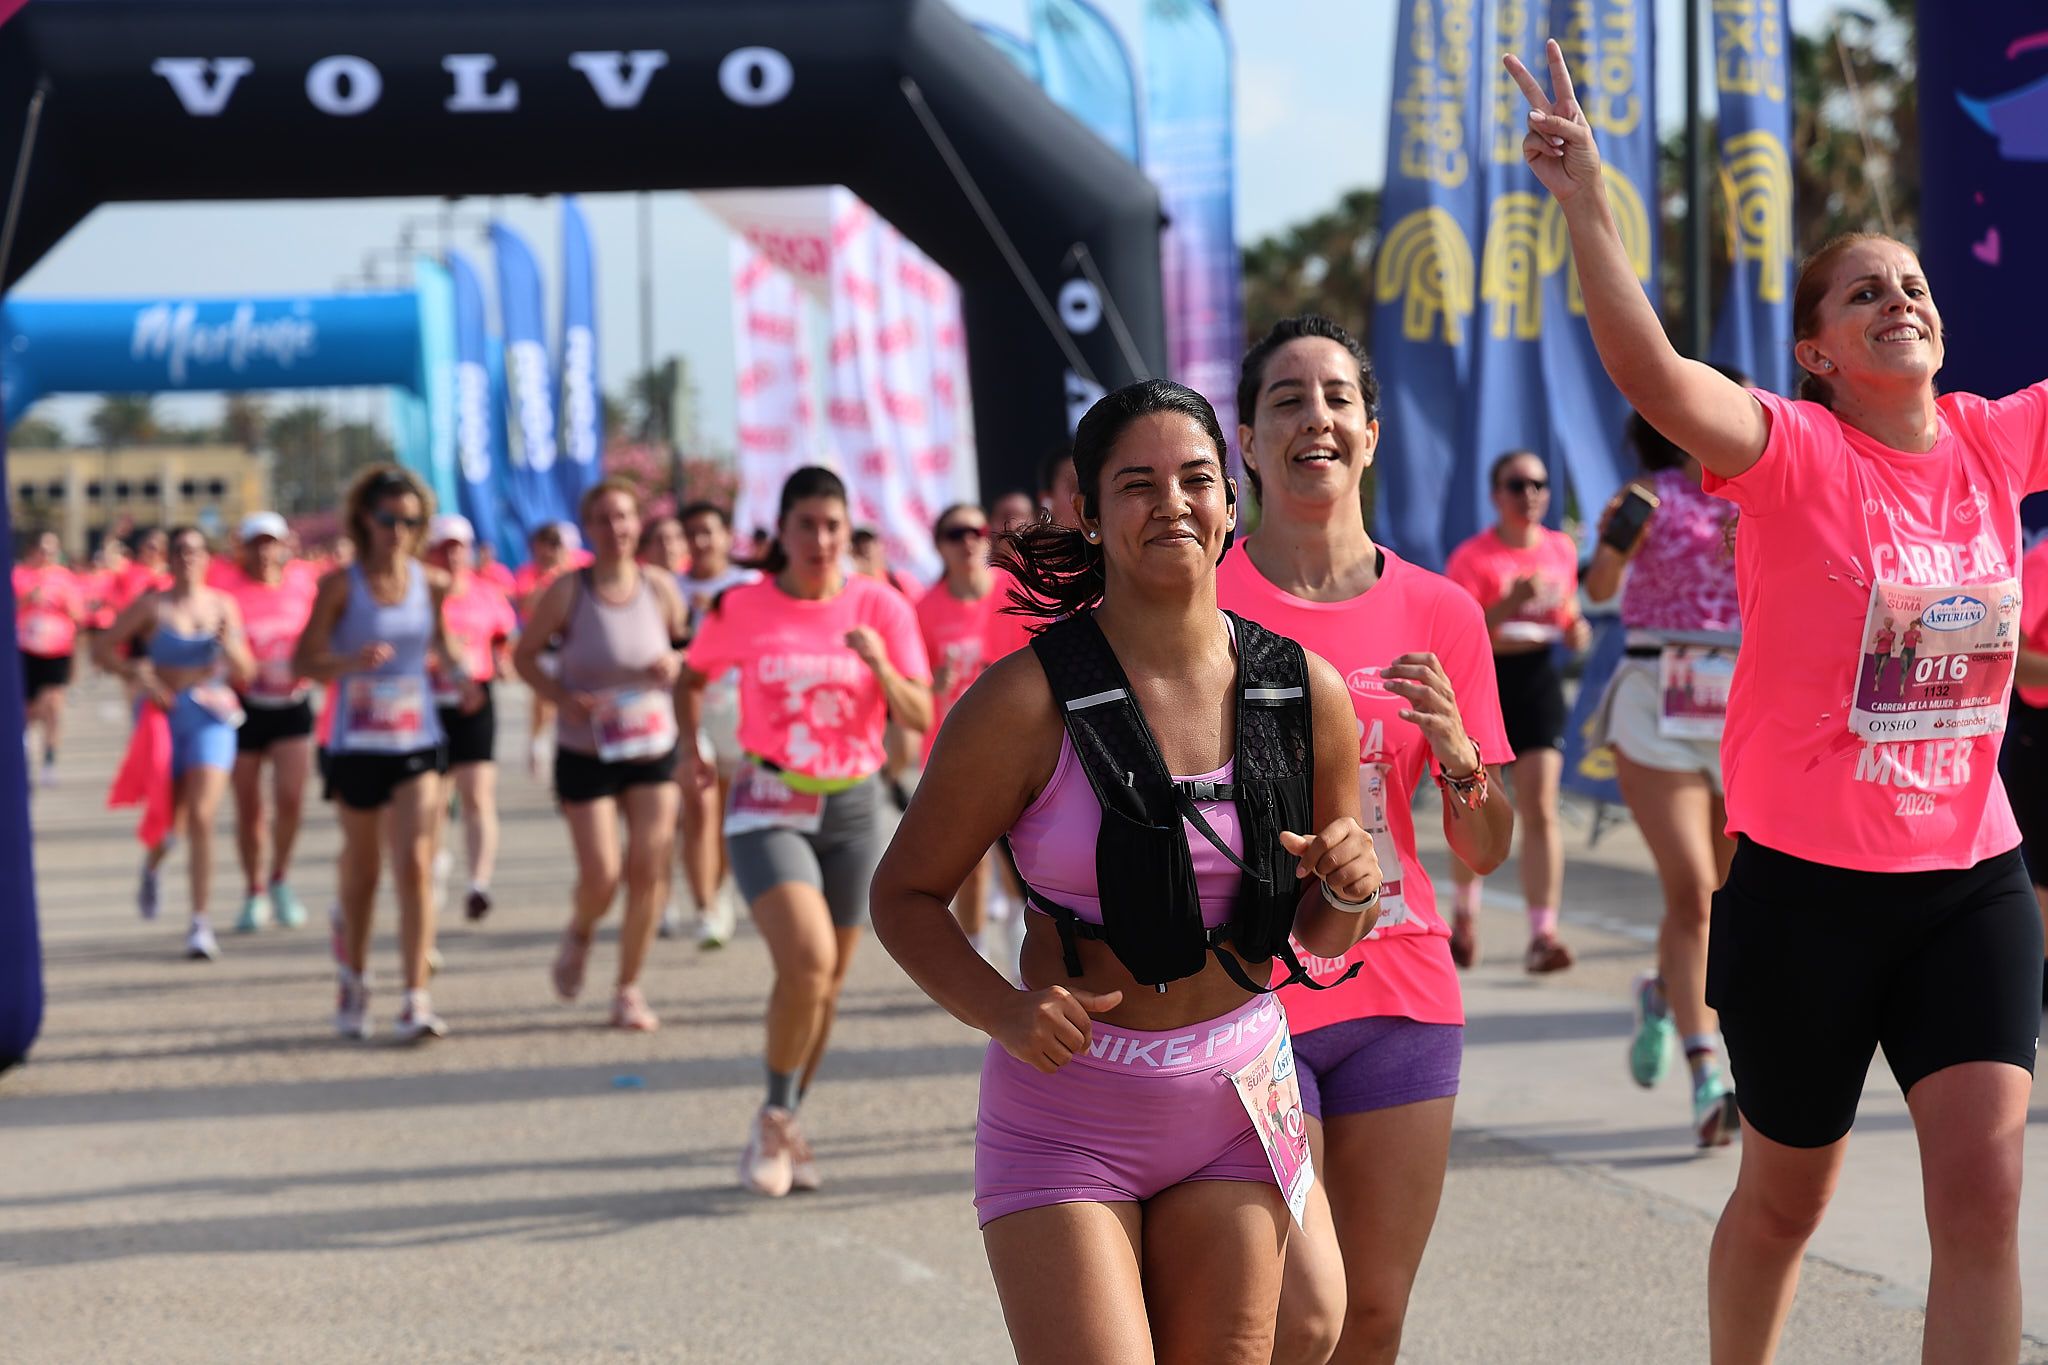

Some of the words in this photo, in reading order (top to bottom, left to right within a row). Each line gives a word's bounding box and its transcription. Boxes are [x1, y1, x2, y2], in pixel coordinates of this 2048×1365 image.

[153, 46, 794, 116] VOLVO
[1872, 534, 2006, 586] CARRERA
[1887, 599, 1922, 613] SUMA
[1926, 610, 1982, 623] ASTURIANA
[1914, 654, 1969, 683] 016
[1871, 701, 1907, 712] CARRERA
[1907, 702, 1917, 711] DE
[1918, 701, 1928, 710] LA
[1929, 699, 1954, 709] MUJER
[1960, 697, 1991, 707] VALENCIA
[1924, 686, 1950, 698] 1132
[1868, 719, 1917, 733] OYSHO
[1945, 717, 1987, 729] Santander
[1854, 740, 1974, 789] MUJER
[1894, 793, 1937, 817] 2026
[1087, 1033, 1196, 1068] NIKE
[1247, 1064, 1271, 1092] SUMA
